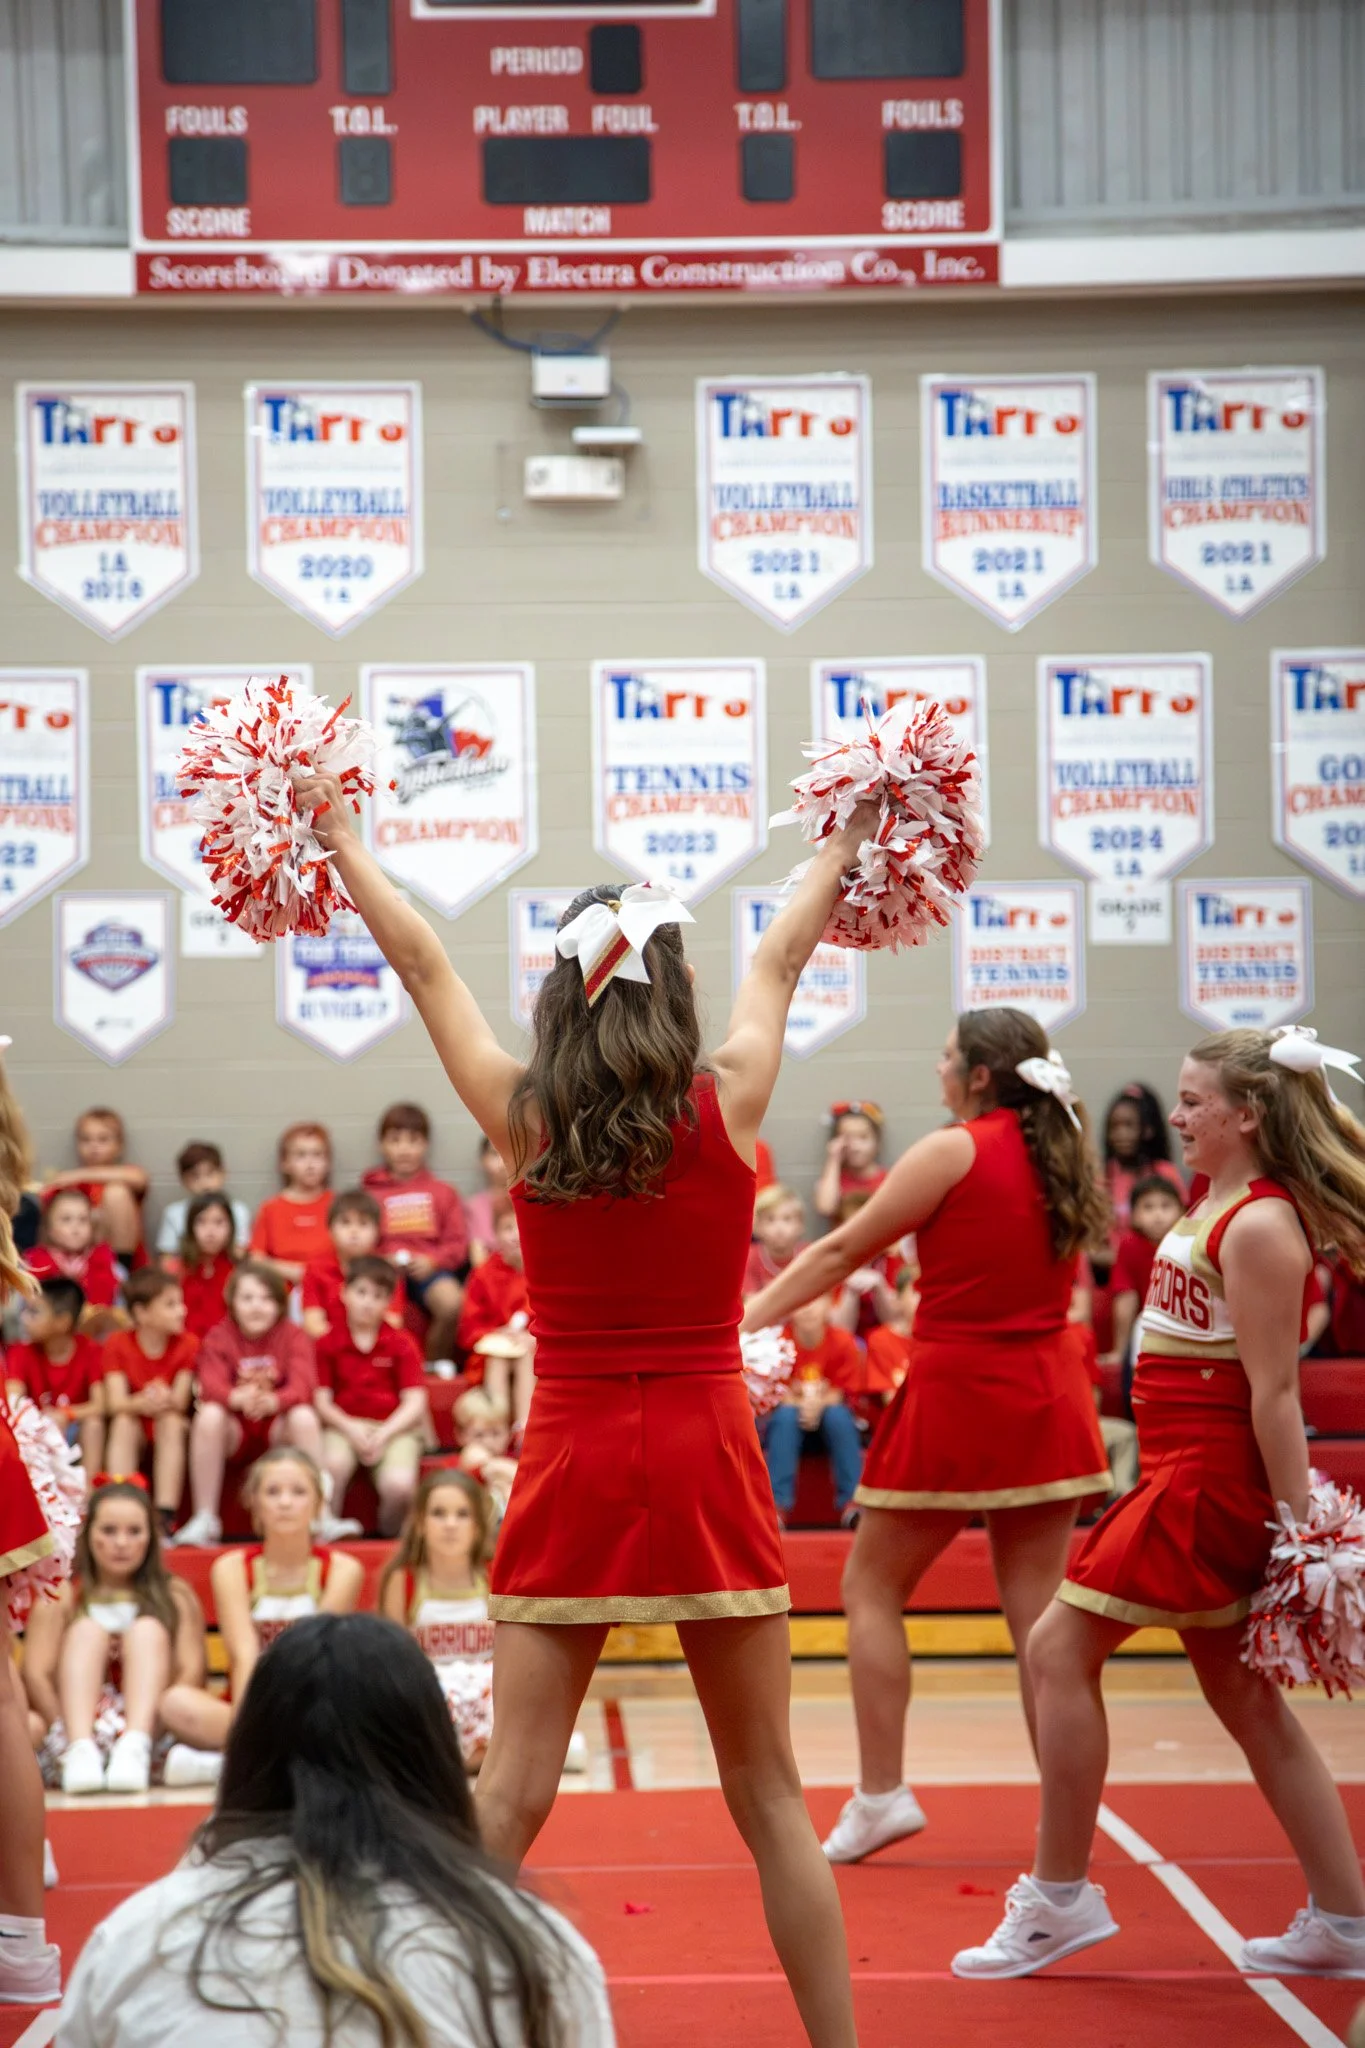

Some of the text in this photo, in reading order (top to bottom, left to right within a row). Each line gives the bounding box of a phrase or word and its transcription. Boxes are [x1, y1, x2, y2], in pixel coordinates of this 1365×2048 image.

[491, 47, 583, 75] PERIOD
[166, 107, 248, 134] FOULS
[473, 105, 568, 134] PLAYER
[882, 99, 964, 129] FOULS
[167, 208, 250, 236] SCORE
[523, 207, 611, 235] MATCH
[882, 201, 964, 230] SCORE
[149, 255, 329, 289] Scorebod
[338, 255, 473, 289] Donated
[479, 255, 520, 294] by
[526, 256, 636, 287] Electra
[640, 254, 845, 286] Construction
[923, 249, 986, 280] Inc.
[711, 511, 858, 542] CHAMPION
[1163, 500, 1309, 531] CHAMPION
[35, 518, 182, 550] CHAMPION
[261, 517, 408, 547] CHAMPION
[299, 554, 374, 580] 2020
[749, 549, 820, 575] 2021
[972, 547, 1045, 574] 2021
[607, 762, 751, 793] TENNIS
[607, 793, 751, 824] CHAMPION
[1051, 789, 1198, 821] CHAMPION
[376, 817, 521, 847] CHAMPION
[644, 829, 717, 857] 2023
[1088, 825, 1163, 853] 2024
